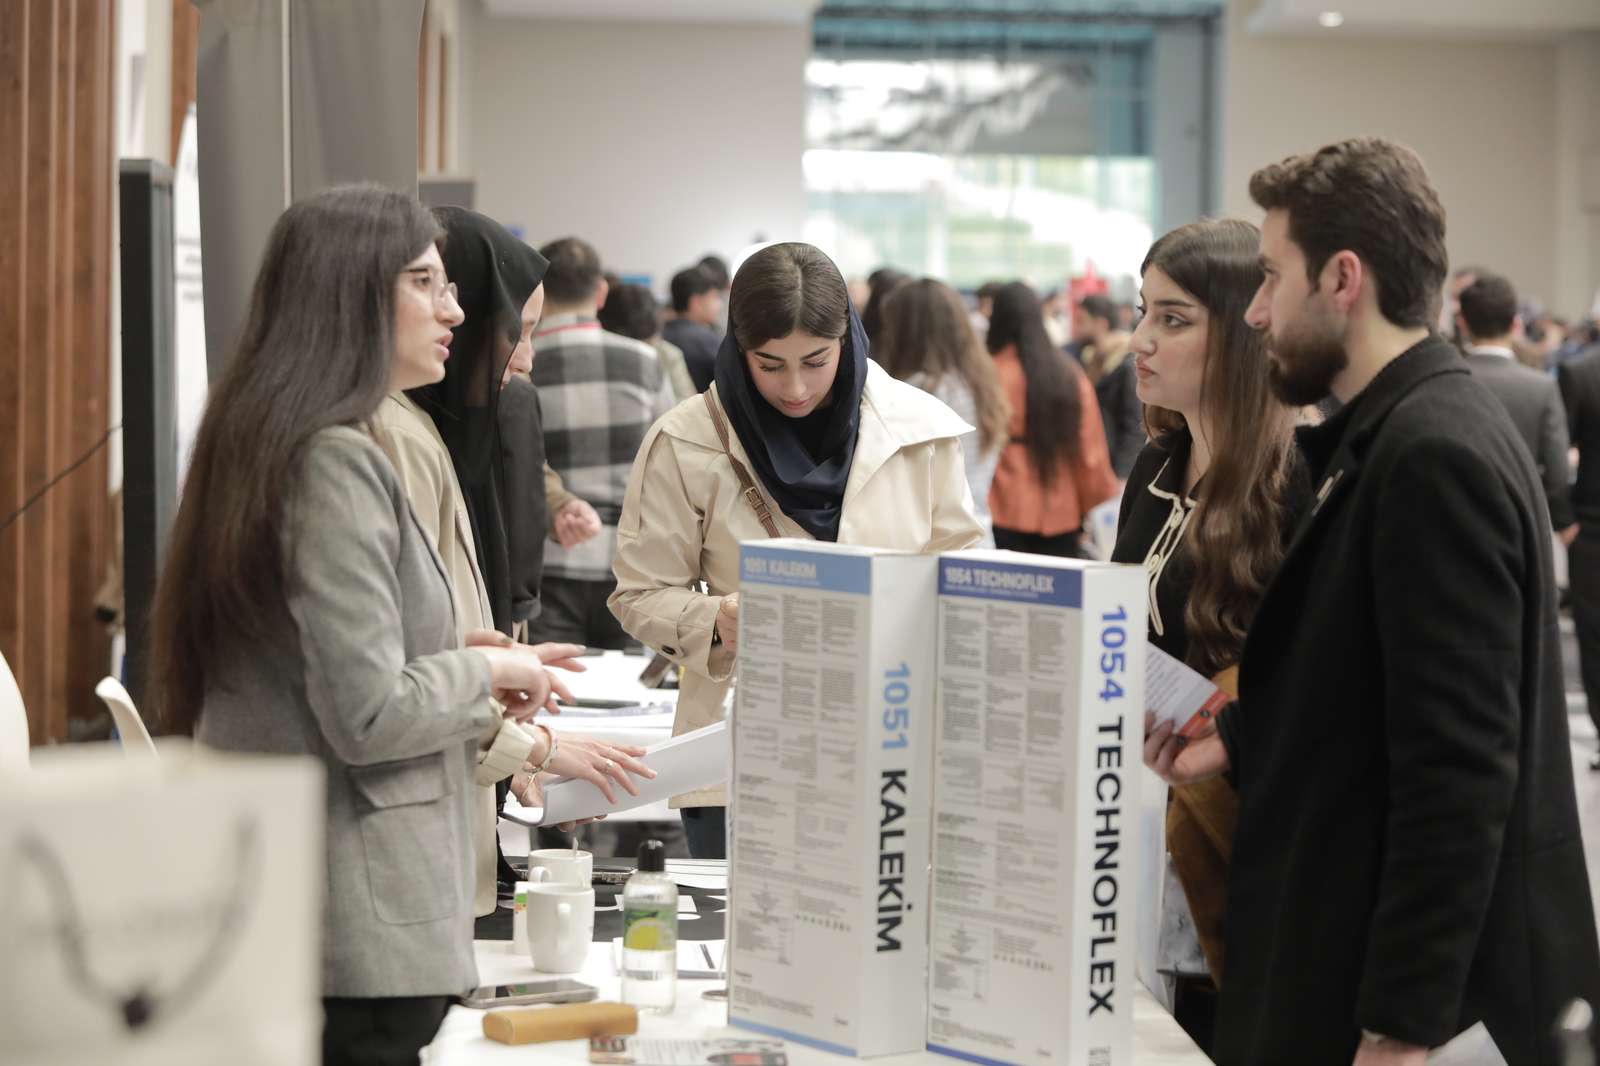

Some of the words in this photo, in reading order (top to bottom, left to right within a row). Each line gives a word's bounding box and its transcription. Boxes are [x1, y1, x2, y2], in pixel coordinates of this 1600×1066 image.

[881, 661, 910, 749] 1051
[1100, 605, 1127, 702] 1054
[877, 769, 912, 952] KALEKİM
[1089, 716, 1122, 1015] TECHNOFLEX
